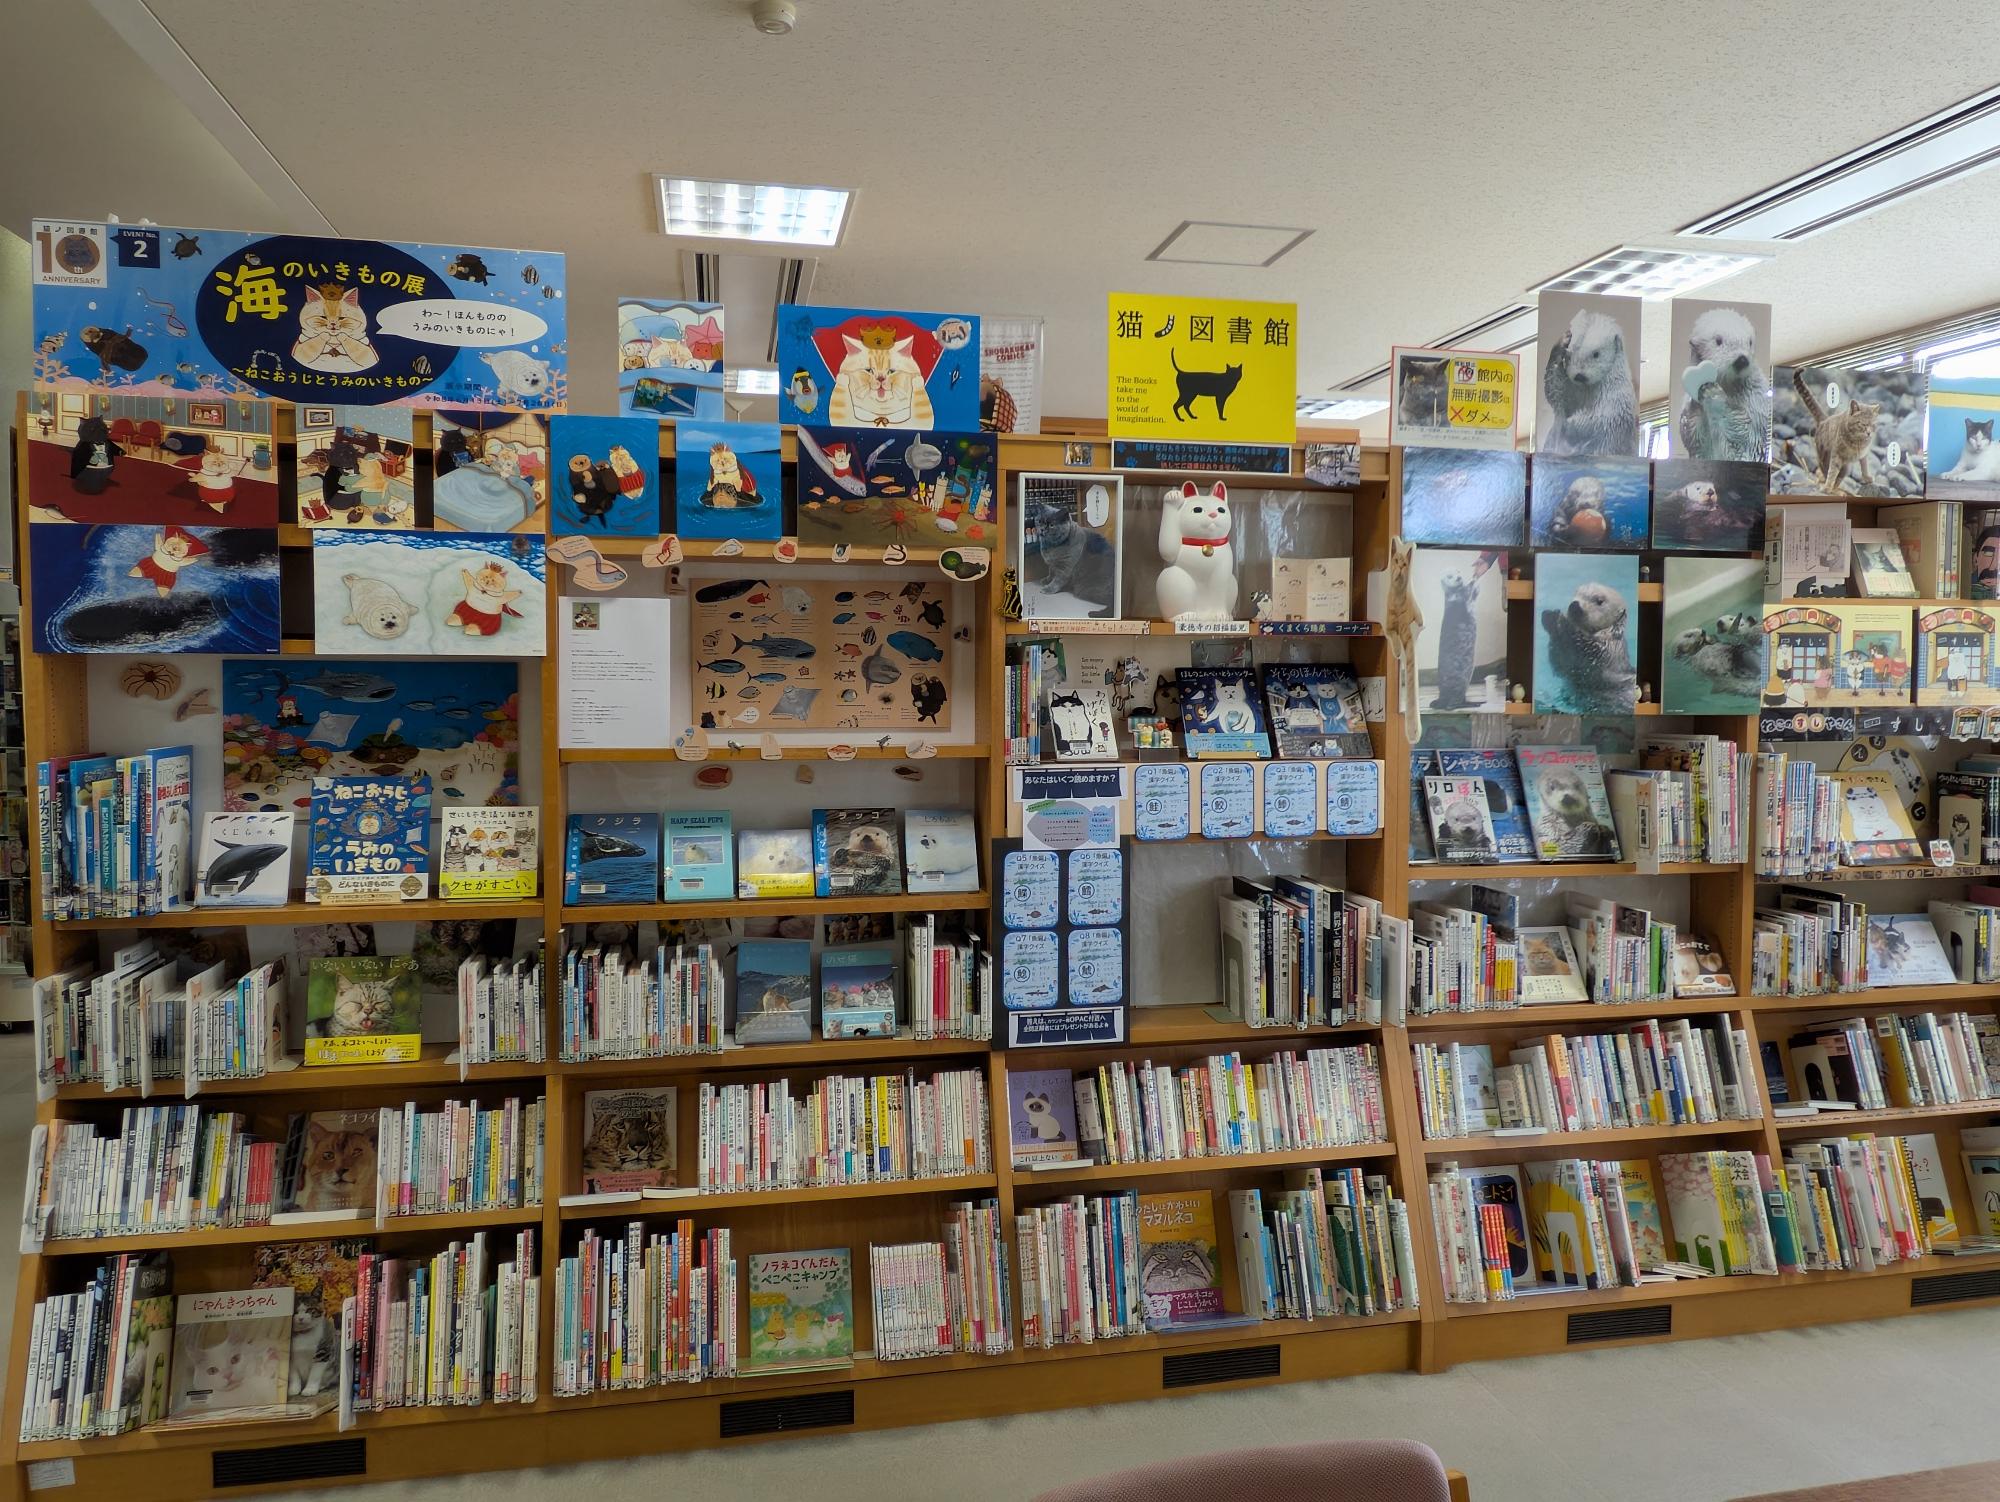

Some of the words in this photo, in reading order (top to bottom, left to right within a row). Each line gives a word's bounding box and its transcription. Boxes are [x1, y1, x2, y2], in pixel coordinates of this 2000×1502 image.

[123, 230, 145, 239] EVENT
[133, 240, 148, 259] 2
[42, 275, 102, 285] ANNIVERSARY
[215, 261, 426, 324] 海のいきもの展
[1116, 309, 1290, 347] 猫ノ図書館
[1116, 375, 1133, 385] The
[1134, 376, 1158, 385] Books
[1477, 368, 1513, 383] 館内の
[1116, 385, 1133, 394] take
[1452, 388, 1510, 404] 無断撮影は
[1116, 395, 1126, 403] to
[1127, 395, 1140, 404] the
[1116, 404, 1139, 413] world
[1140, 404, 1150, 413] of
[1116, 414, 1166, 424] imagination.
[1761, 712, 1854, 733] ねこのすしやさん
[1890, 716, 1924, 733] すし
[596, 815, 643, 826] クジラ
[838, 811, 880, 821] ラッコ
[345, 840, 394, 856] うみの
[334, 857, 401, 873] いきもの
[450, 880, 532, 892] クセがすごい。
[312, 960, 345, 973] いない
[350, 959, 384, 970] いない
[389, 958, 419, 971] にゃあ
[1143, 1210, 1194, 1227] マヌルネコ
[761, 1256, 839, 1273] ノラネコぐんだん
[761, 1267, 840, 1285] ぺこぺこキャンプ
